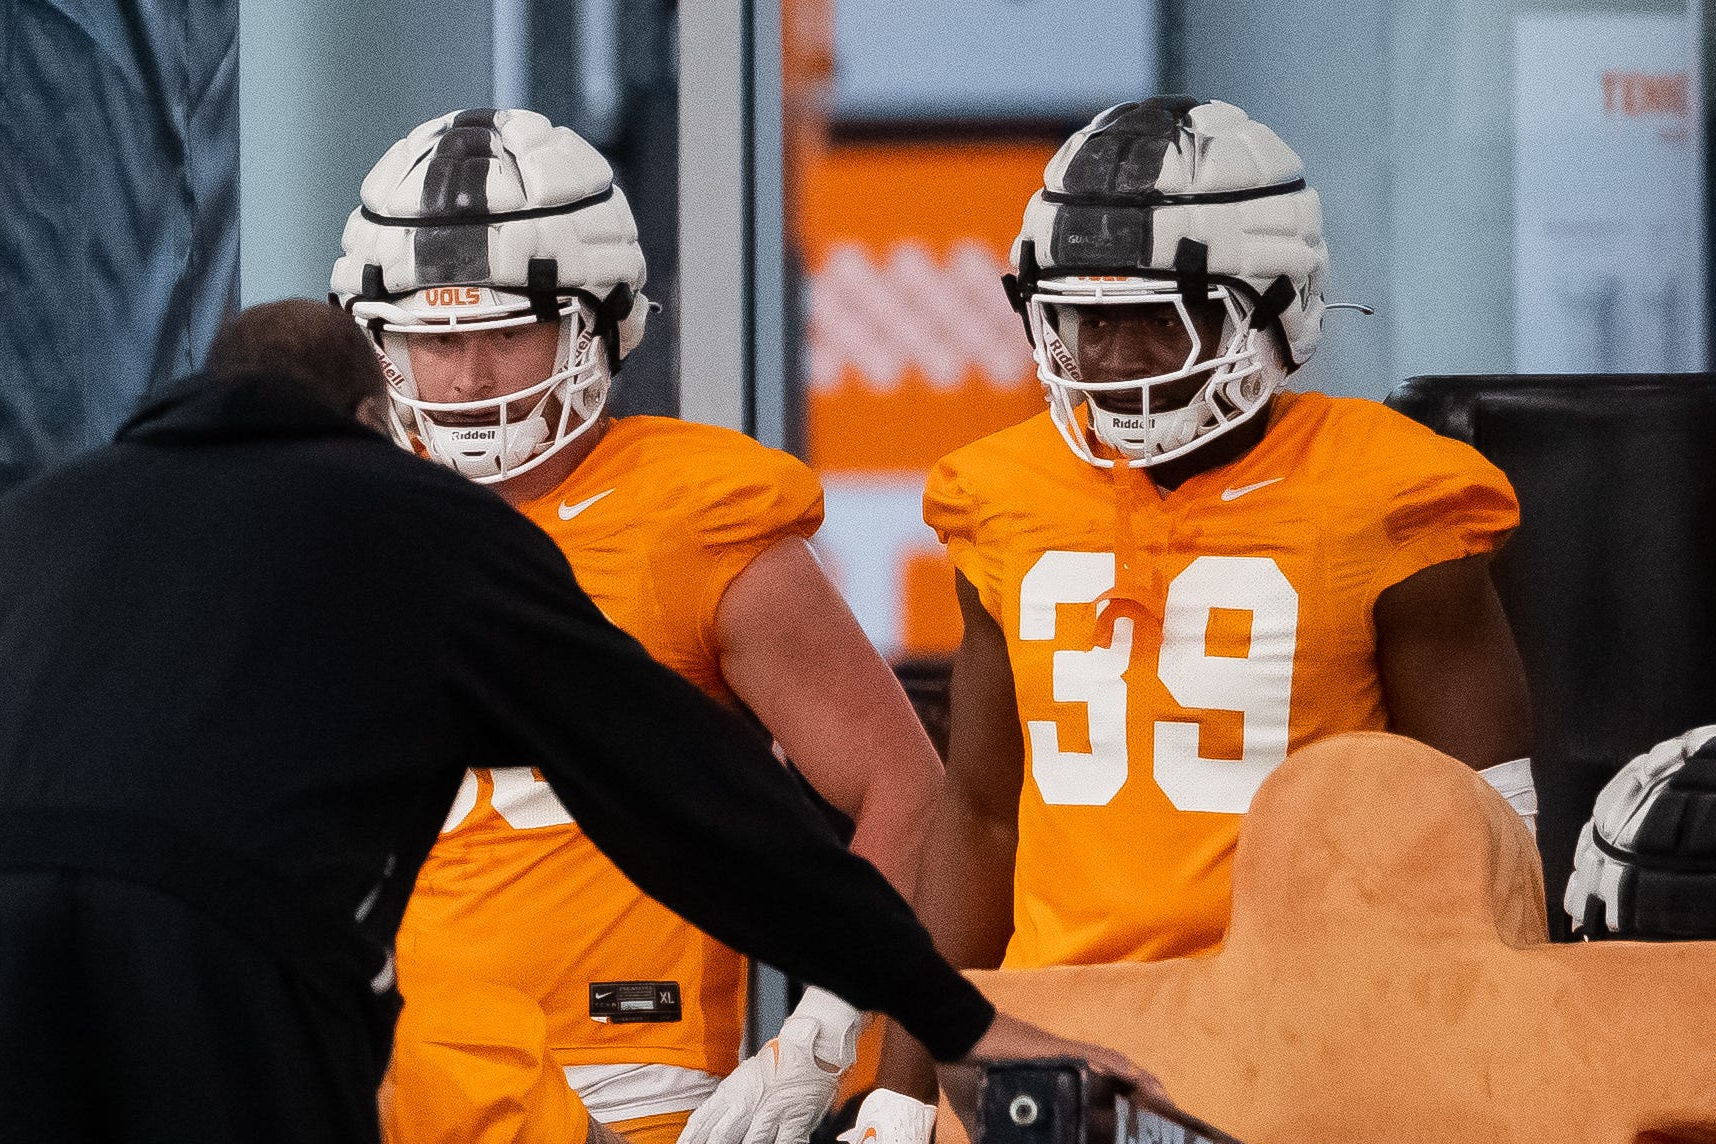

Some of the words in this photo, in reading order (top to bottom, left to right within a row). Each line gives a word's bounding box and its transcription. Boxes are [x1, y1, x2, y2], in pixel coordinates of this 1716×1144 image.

[424, 287, 481, 306] VOLS
[1019, 550, 1300, 815] 39
[659, 991, 675, 1004] XL
